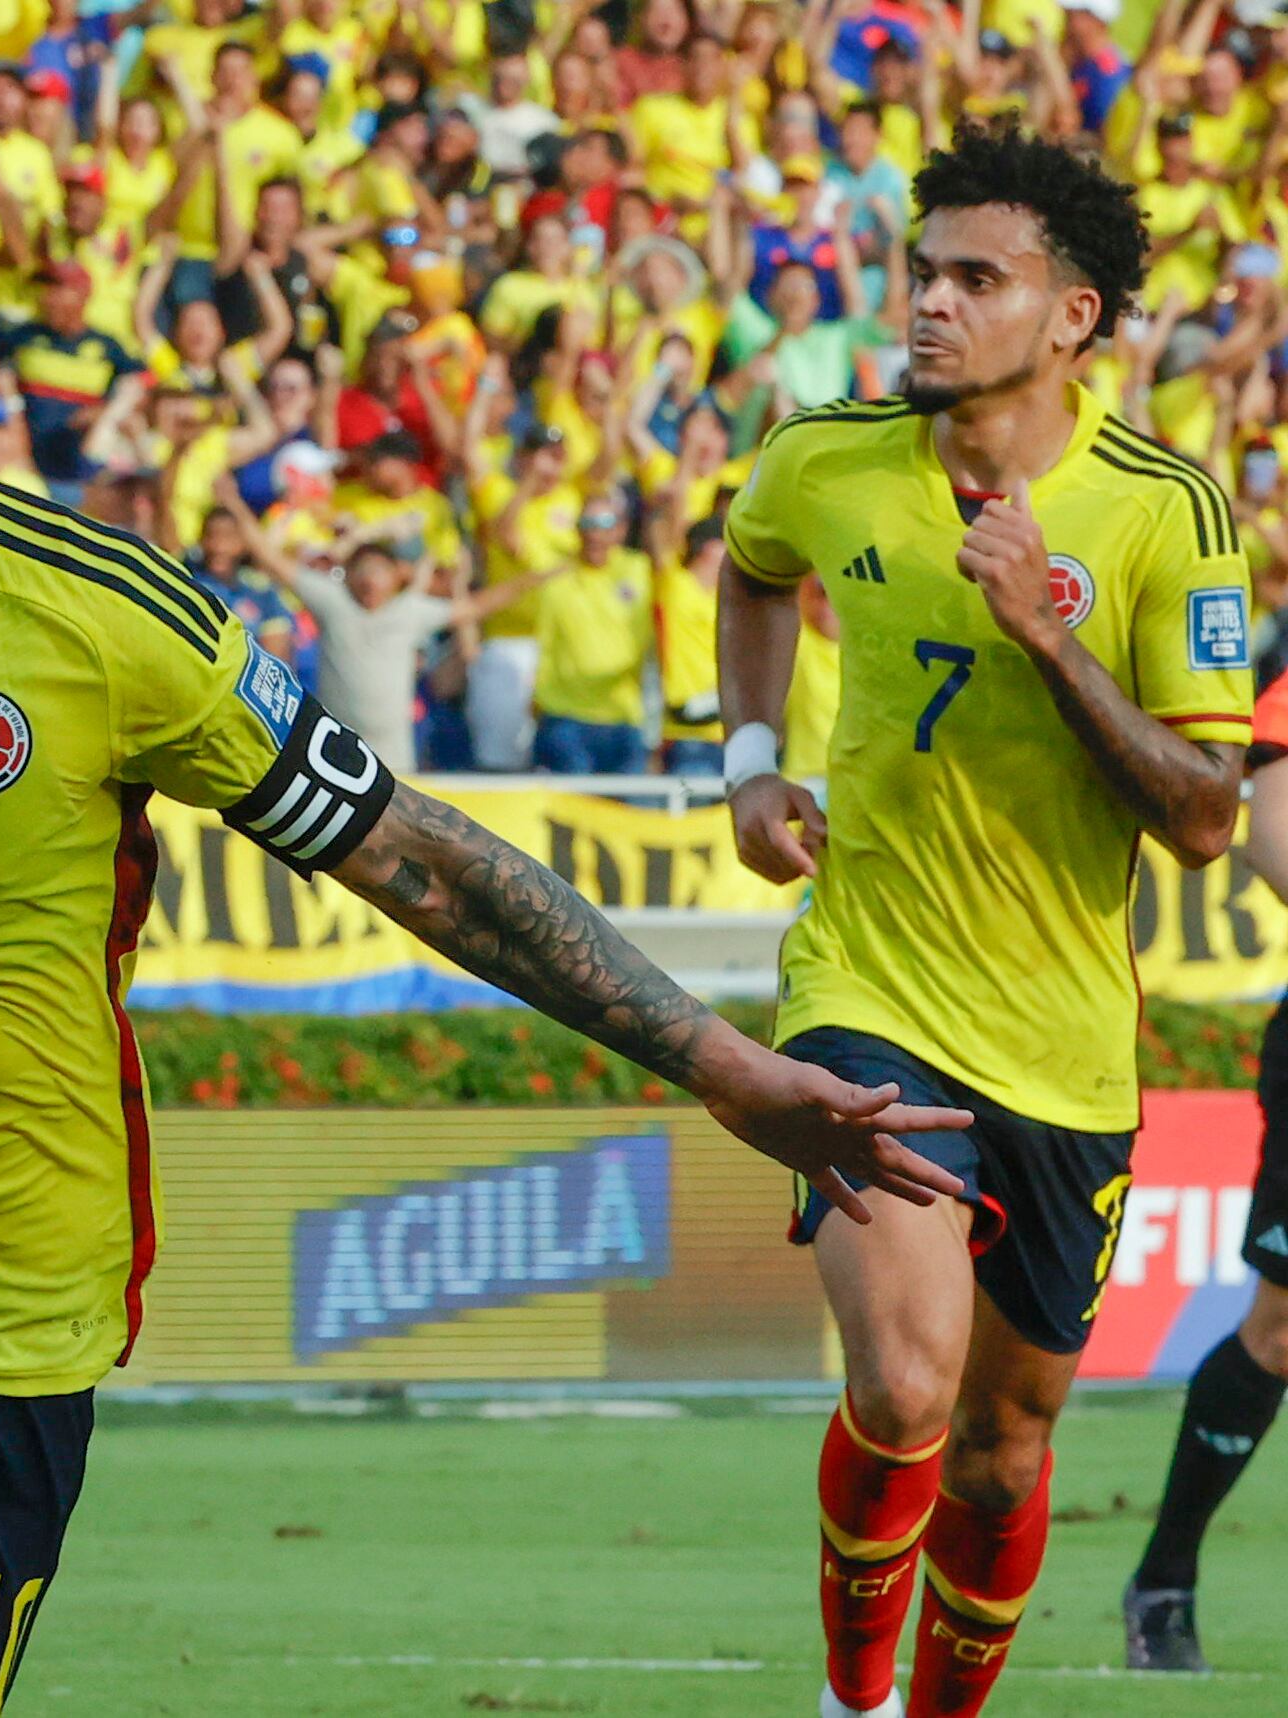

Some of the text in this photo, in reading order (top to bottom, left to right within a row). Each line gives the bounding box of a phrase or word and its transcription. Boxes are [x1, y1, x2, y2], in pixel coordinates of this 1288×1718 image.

[914, 638, 975, 752] 7
[307, 715, 378, 795] C
[315, 1150, 645, 1338] AGUILA
[932, 1619, 1011, 1665] FCF
